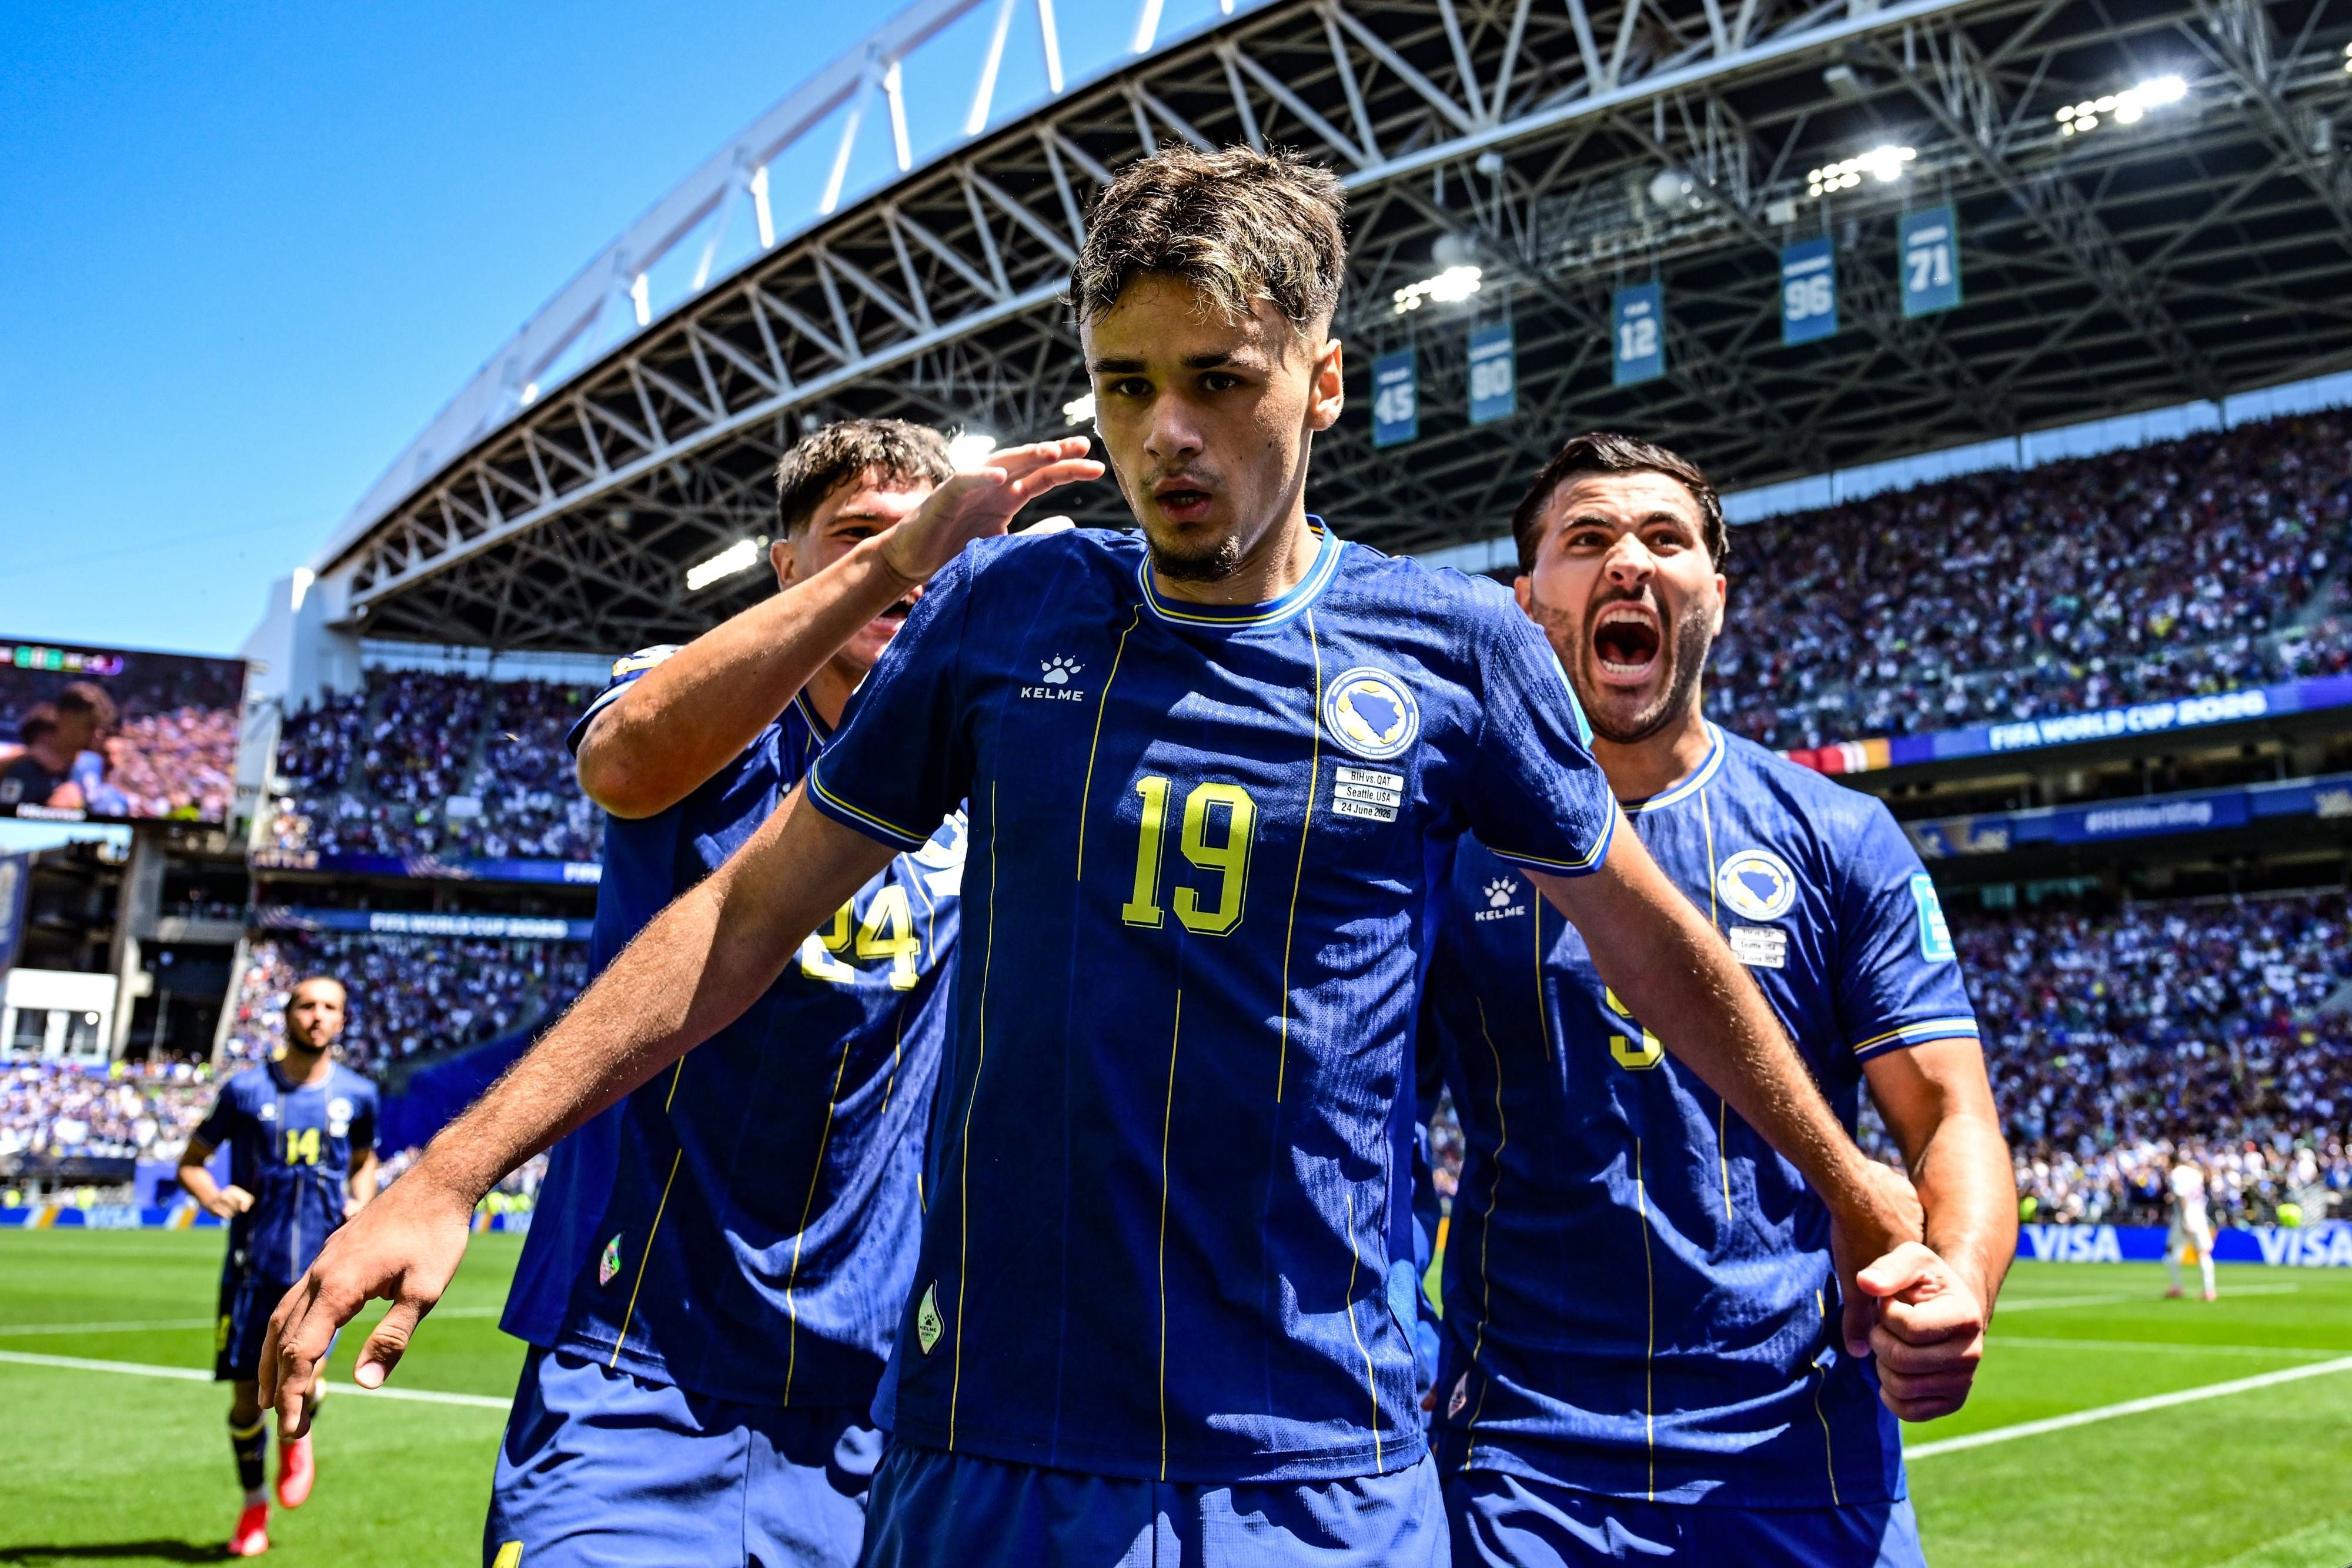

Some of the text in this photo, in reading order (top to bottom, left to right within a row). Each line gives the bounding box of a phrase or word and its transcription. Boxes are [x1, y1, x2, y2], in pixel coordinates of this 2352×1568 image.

[1906, 244, 1952, 292] 71
[1785, 275, 1833, 320] 96
[1621, 317, 1656, 362] 12
[1374, 383, 1414, 424] 45
[1021, 687, 1084, 701] KELME
[1989, 690, 2267, 751] FIFA WORLD CUP 2026
[1347, 786, 1391, 803] Seattle, USA
[1351, 771, 1391, 786] BIH vs. QAT
[1341, 802, 1391, 818] 24 June 2026
[1121, 775, 1258, 937] 19
[1475, 905, 1525, 922] KELME
[285, 1127, 320, 1166] 14
[2026, 1224, 2123, 1263] VISA
